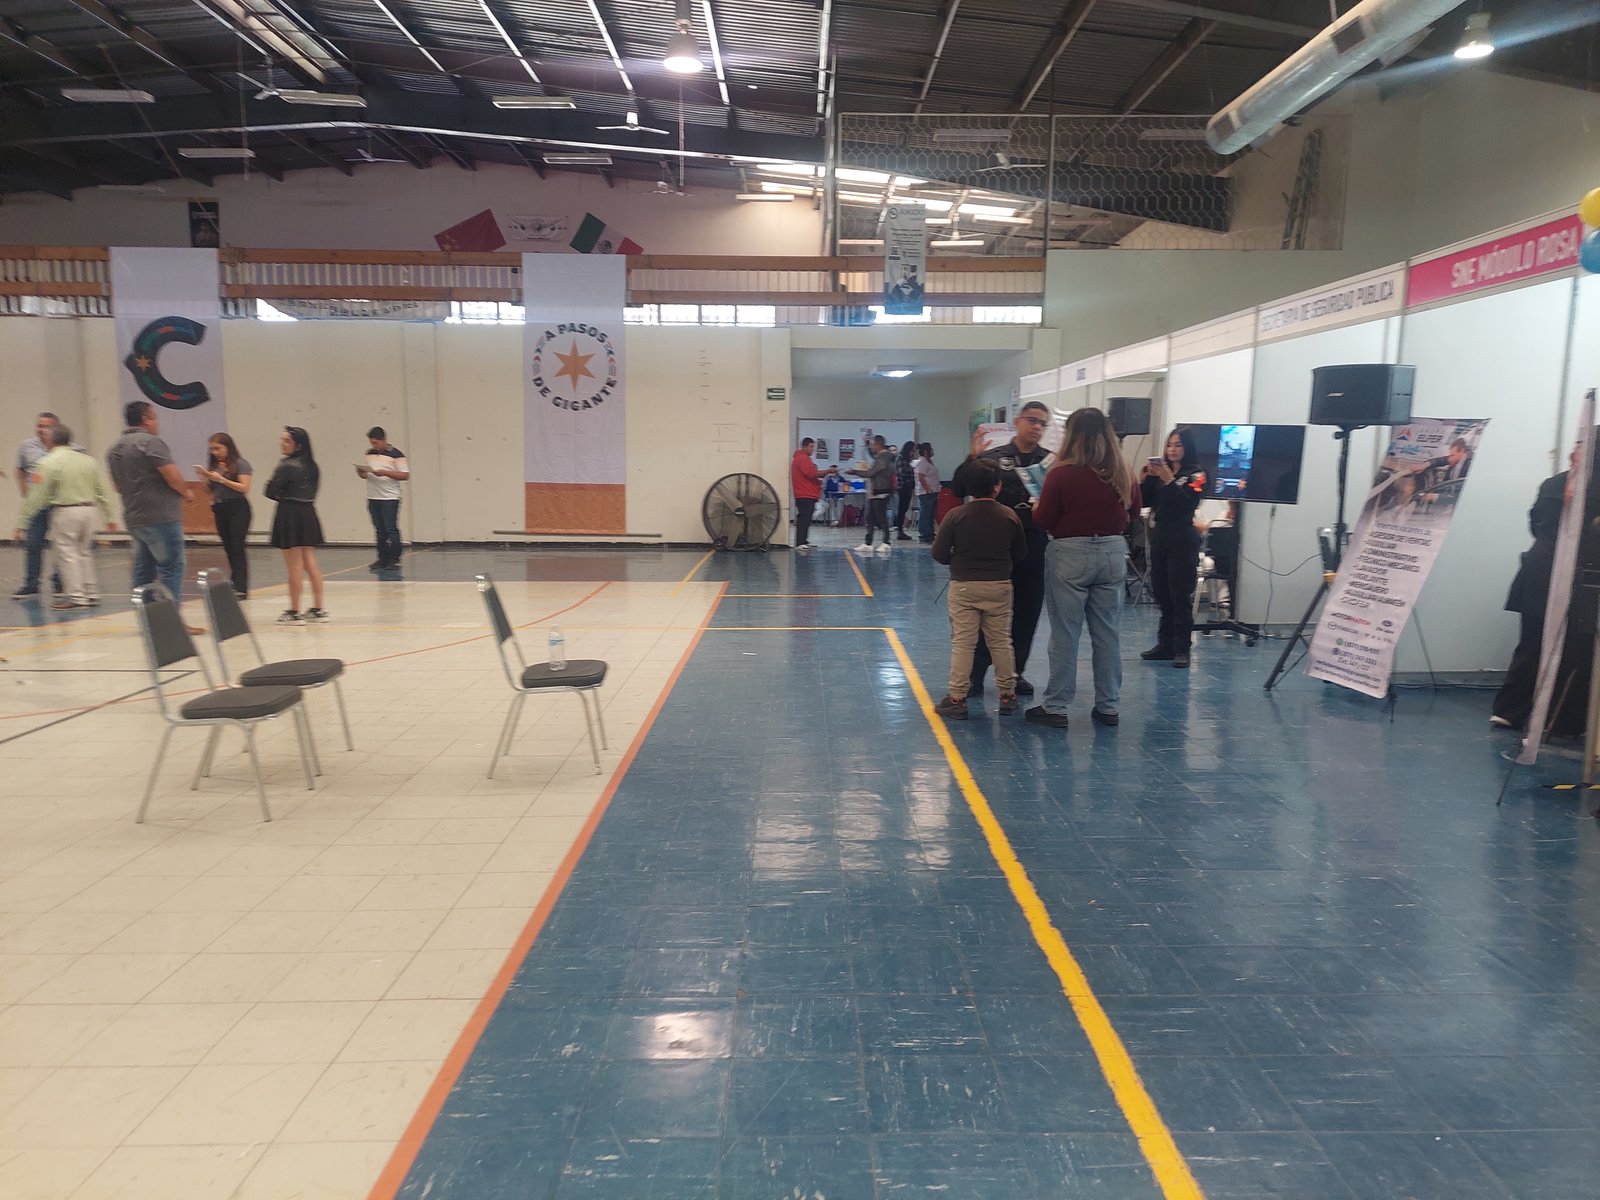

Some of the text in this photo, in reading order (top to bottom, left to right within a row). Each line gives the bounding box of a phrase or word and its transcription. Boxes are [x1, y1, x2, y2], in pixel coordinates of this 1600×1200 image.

[1451, 226, 1578, 289] SNE MÓDULO ROSA
[544, 322, 608, 344] A PASOS
[532, 376, 618, 412] DE GIGANTE
